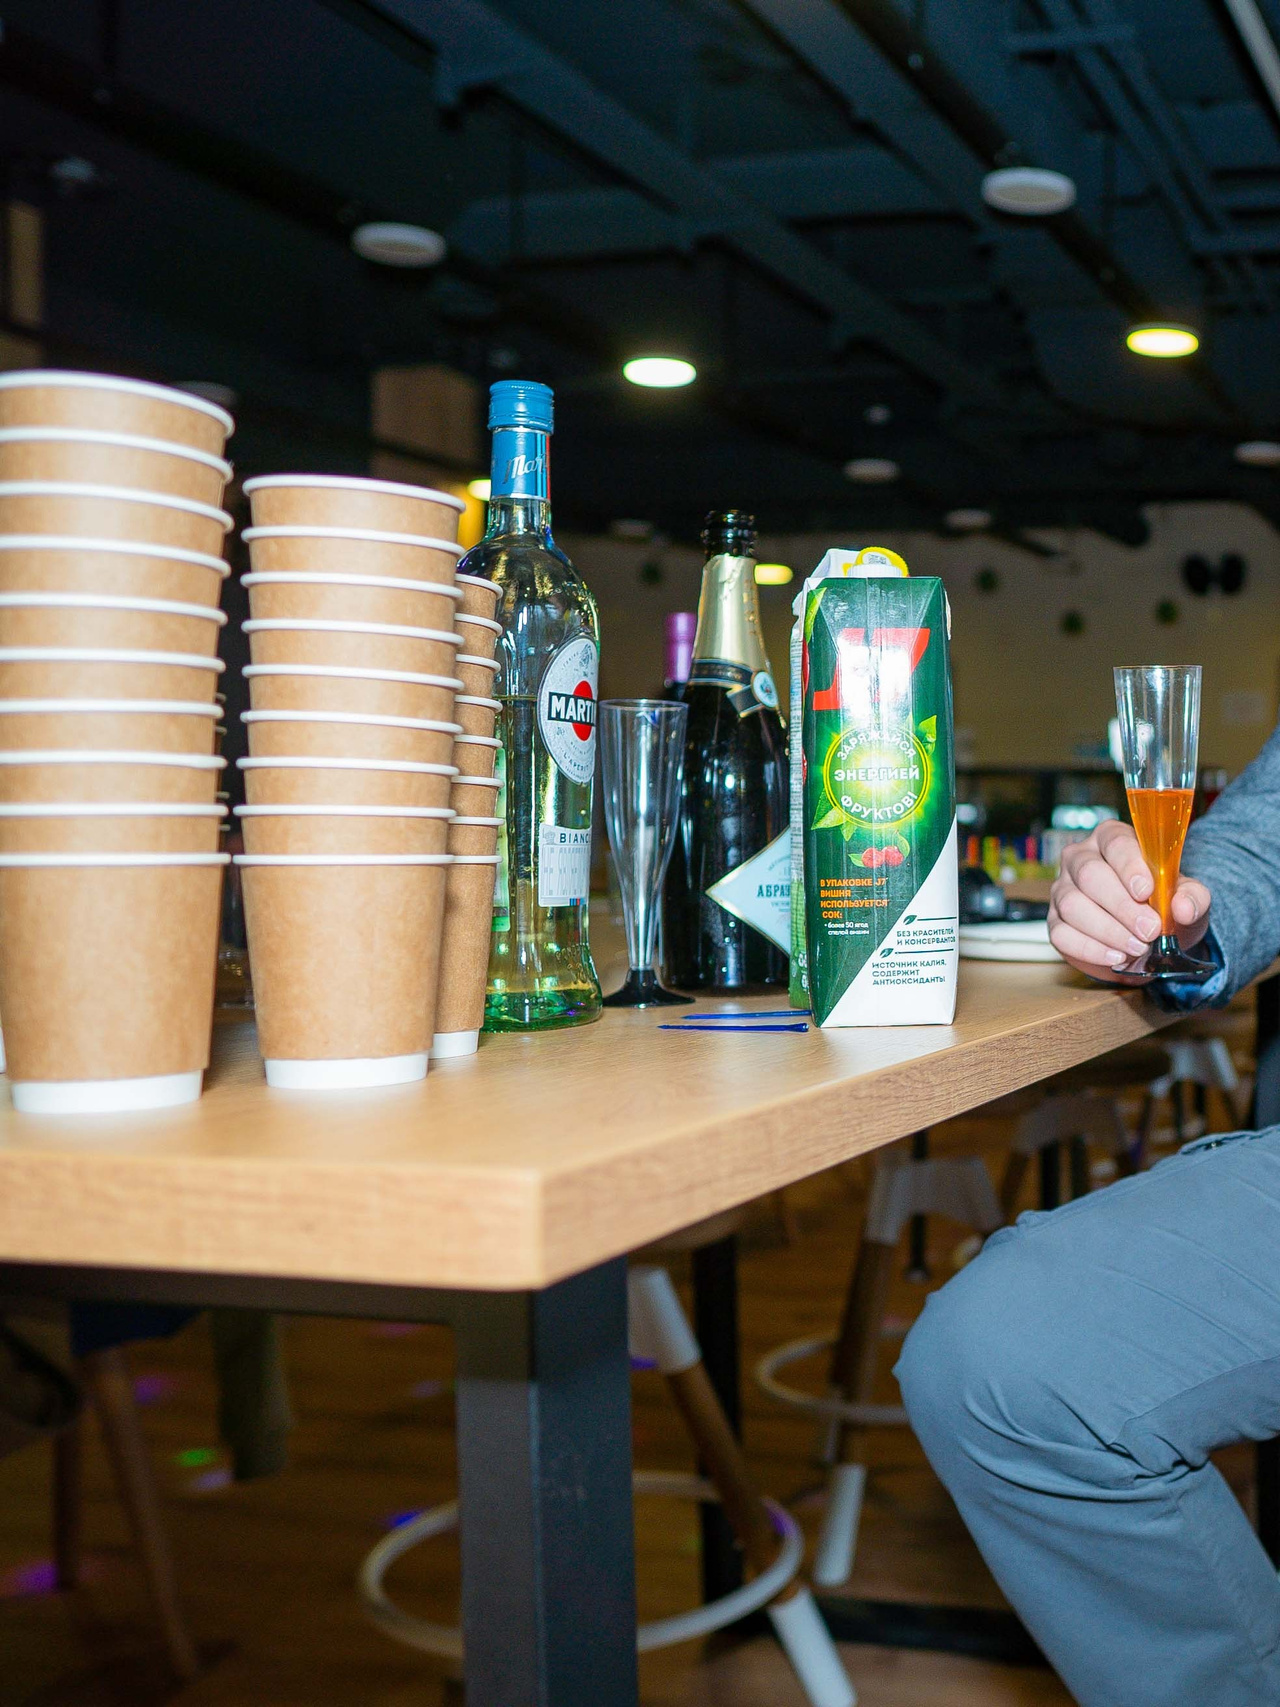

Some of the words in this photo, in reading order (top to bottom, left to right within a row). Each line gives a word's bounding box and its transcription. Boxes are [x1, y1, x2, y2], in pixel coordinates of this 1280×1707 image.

[834, 764, 919, 781] ЭНЕРГИЕЙ
[820, 879, 826, 887] В
[826, 878, 873, 887] УПАКОВКЕ
[820, 889, 852, 898] ВИШНЯ
[822, 911, 843, 919] СОК:
[912, 927, 954, 937] КРАСИТЕЛЕЙ
[904, 936, 956, 946] КОНСЕРВАНТОВ
[872, 960, 918, 969] ИСТОЧНИК
[872, 969, 920, 978] СОДЕРЖИТ
[872, 976, 946, 986] АНТИОКСИДАНТЫ
